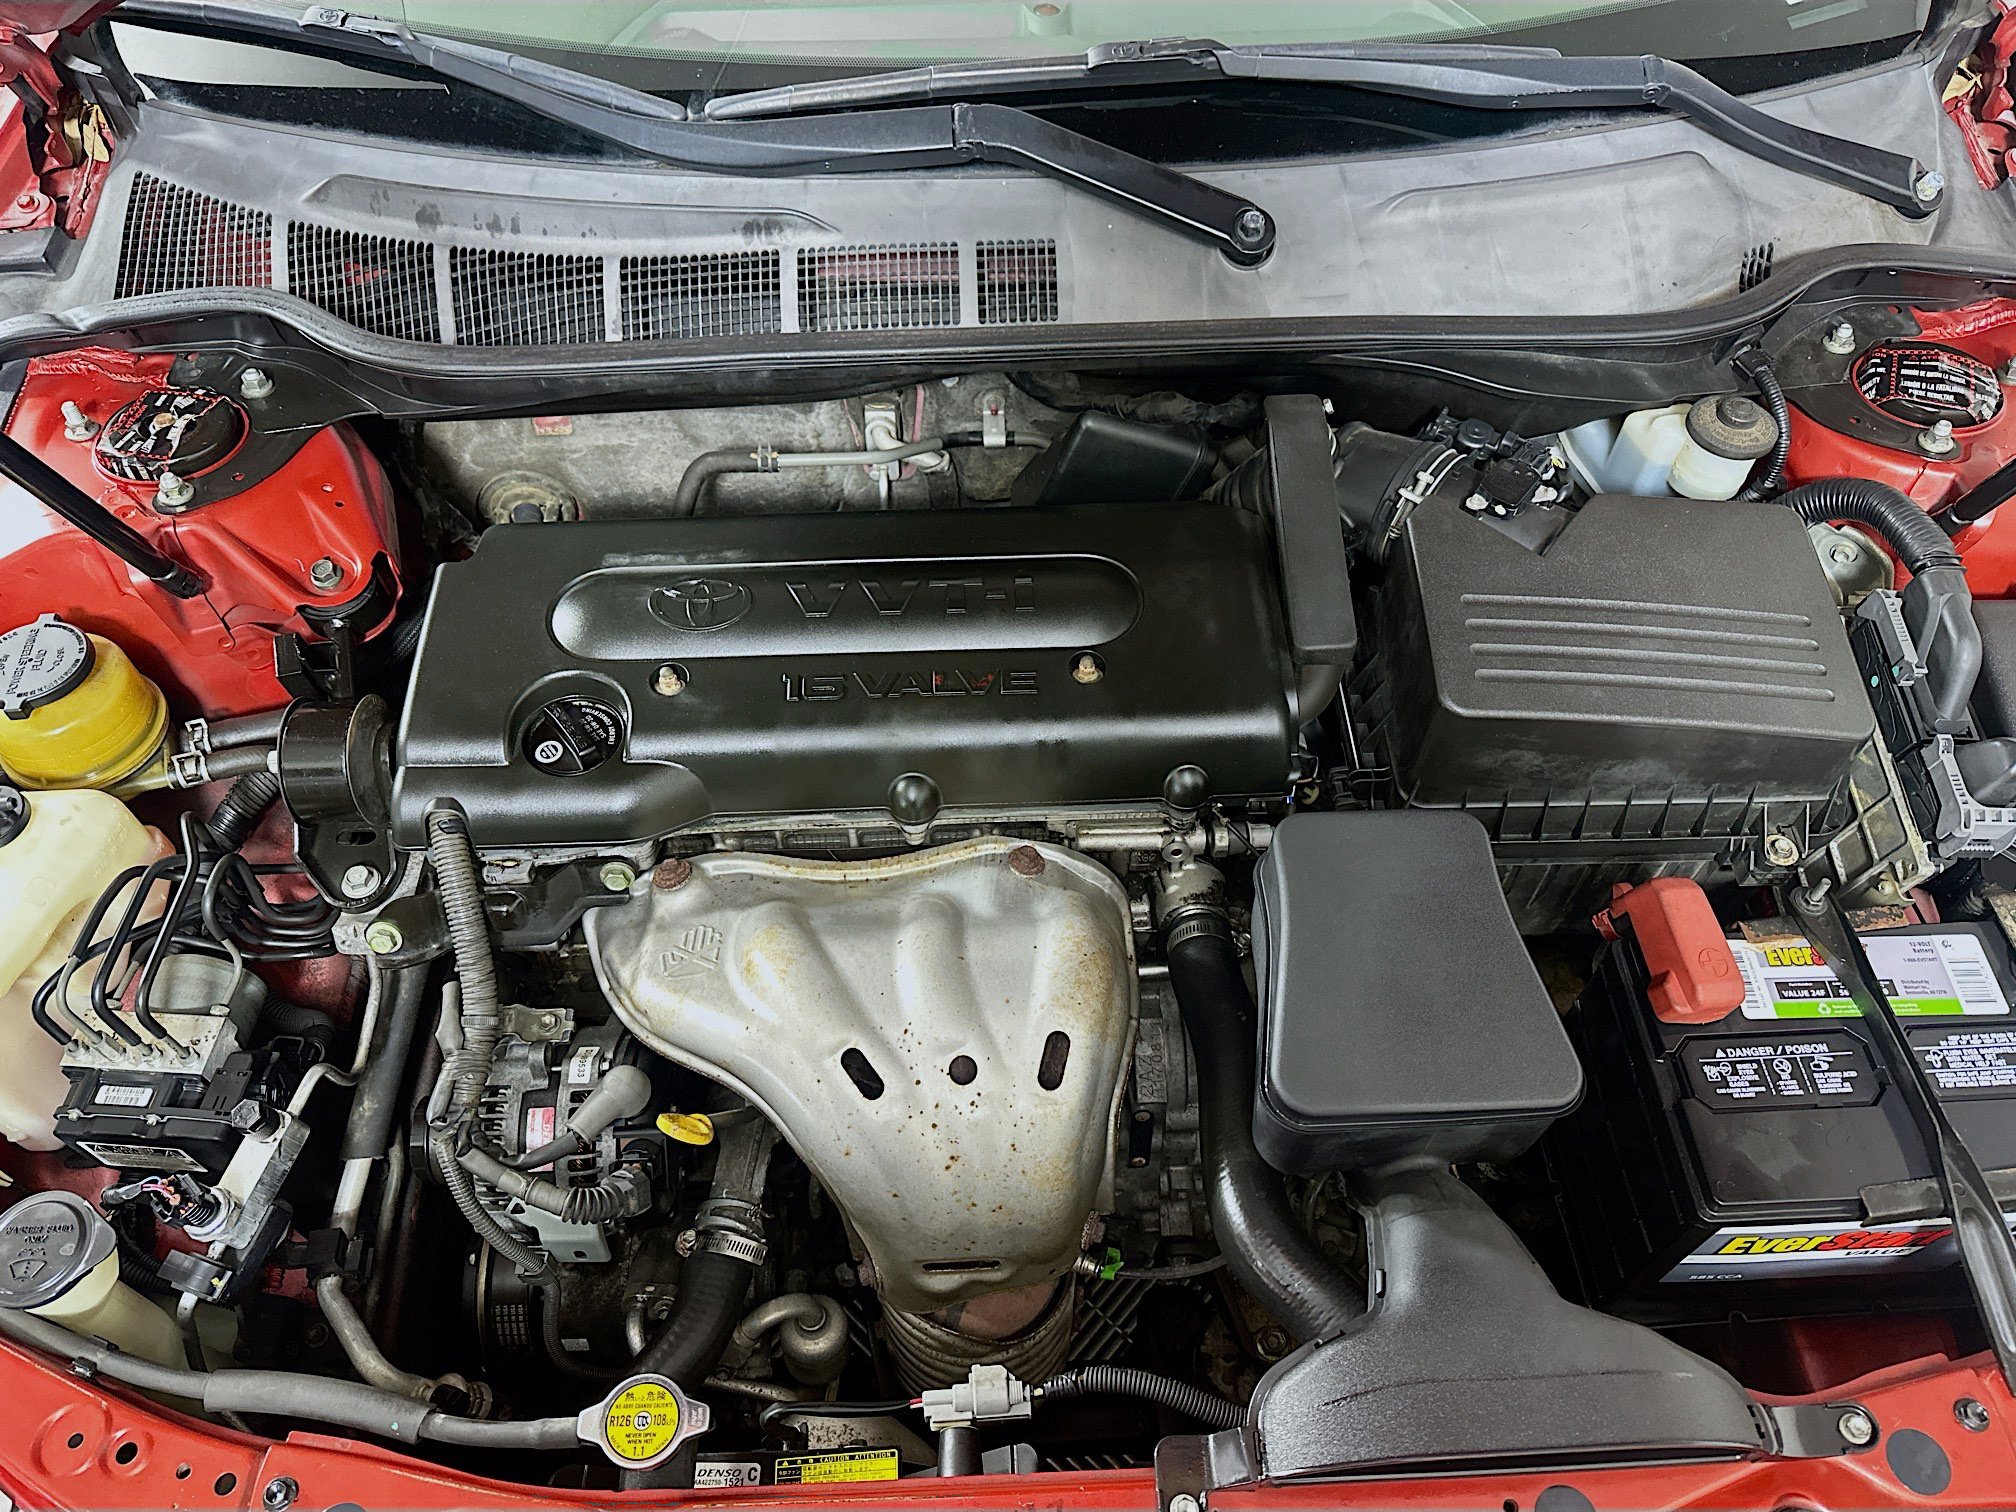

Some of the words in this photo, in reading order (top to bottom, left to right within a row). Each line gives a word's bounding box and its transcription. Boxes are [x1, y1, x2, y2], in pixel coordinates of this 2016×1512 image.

[5, 666, 26, 695] POWER
[18, 628, 40, 666] STEERING
[30, 649, 47, 671] FLUID
[781, 672, 848, 702] 16
[852, 670, 1040, 698] VALVE
[1781, 990, 1811, 998] VALUE
[1725, 1046, 1775, 1058] DANGER
[1784, 1043, 1830, 1055] POISON
[1843, 1070, 1858, 1078] ACID
[1718, 1229, 1954, 1255] EverStart
[1845, 1247, 1909, 1257] VALUE
[609, 1414, 632, 1428] R126
[819, 1455, 850, 1465] CAUTION
[854, 1452, 891, 1462] ATTENTION
[697, 1468, 742, 1478] DENSO
[747, 1466, 758, 1483] C
